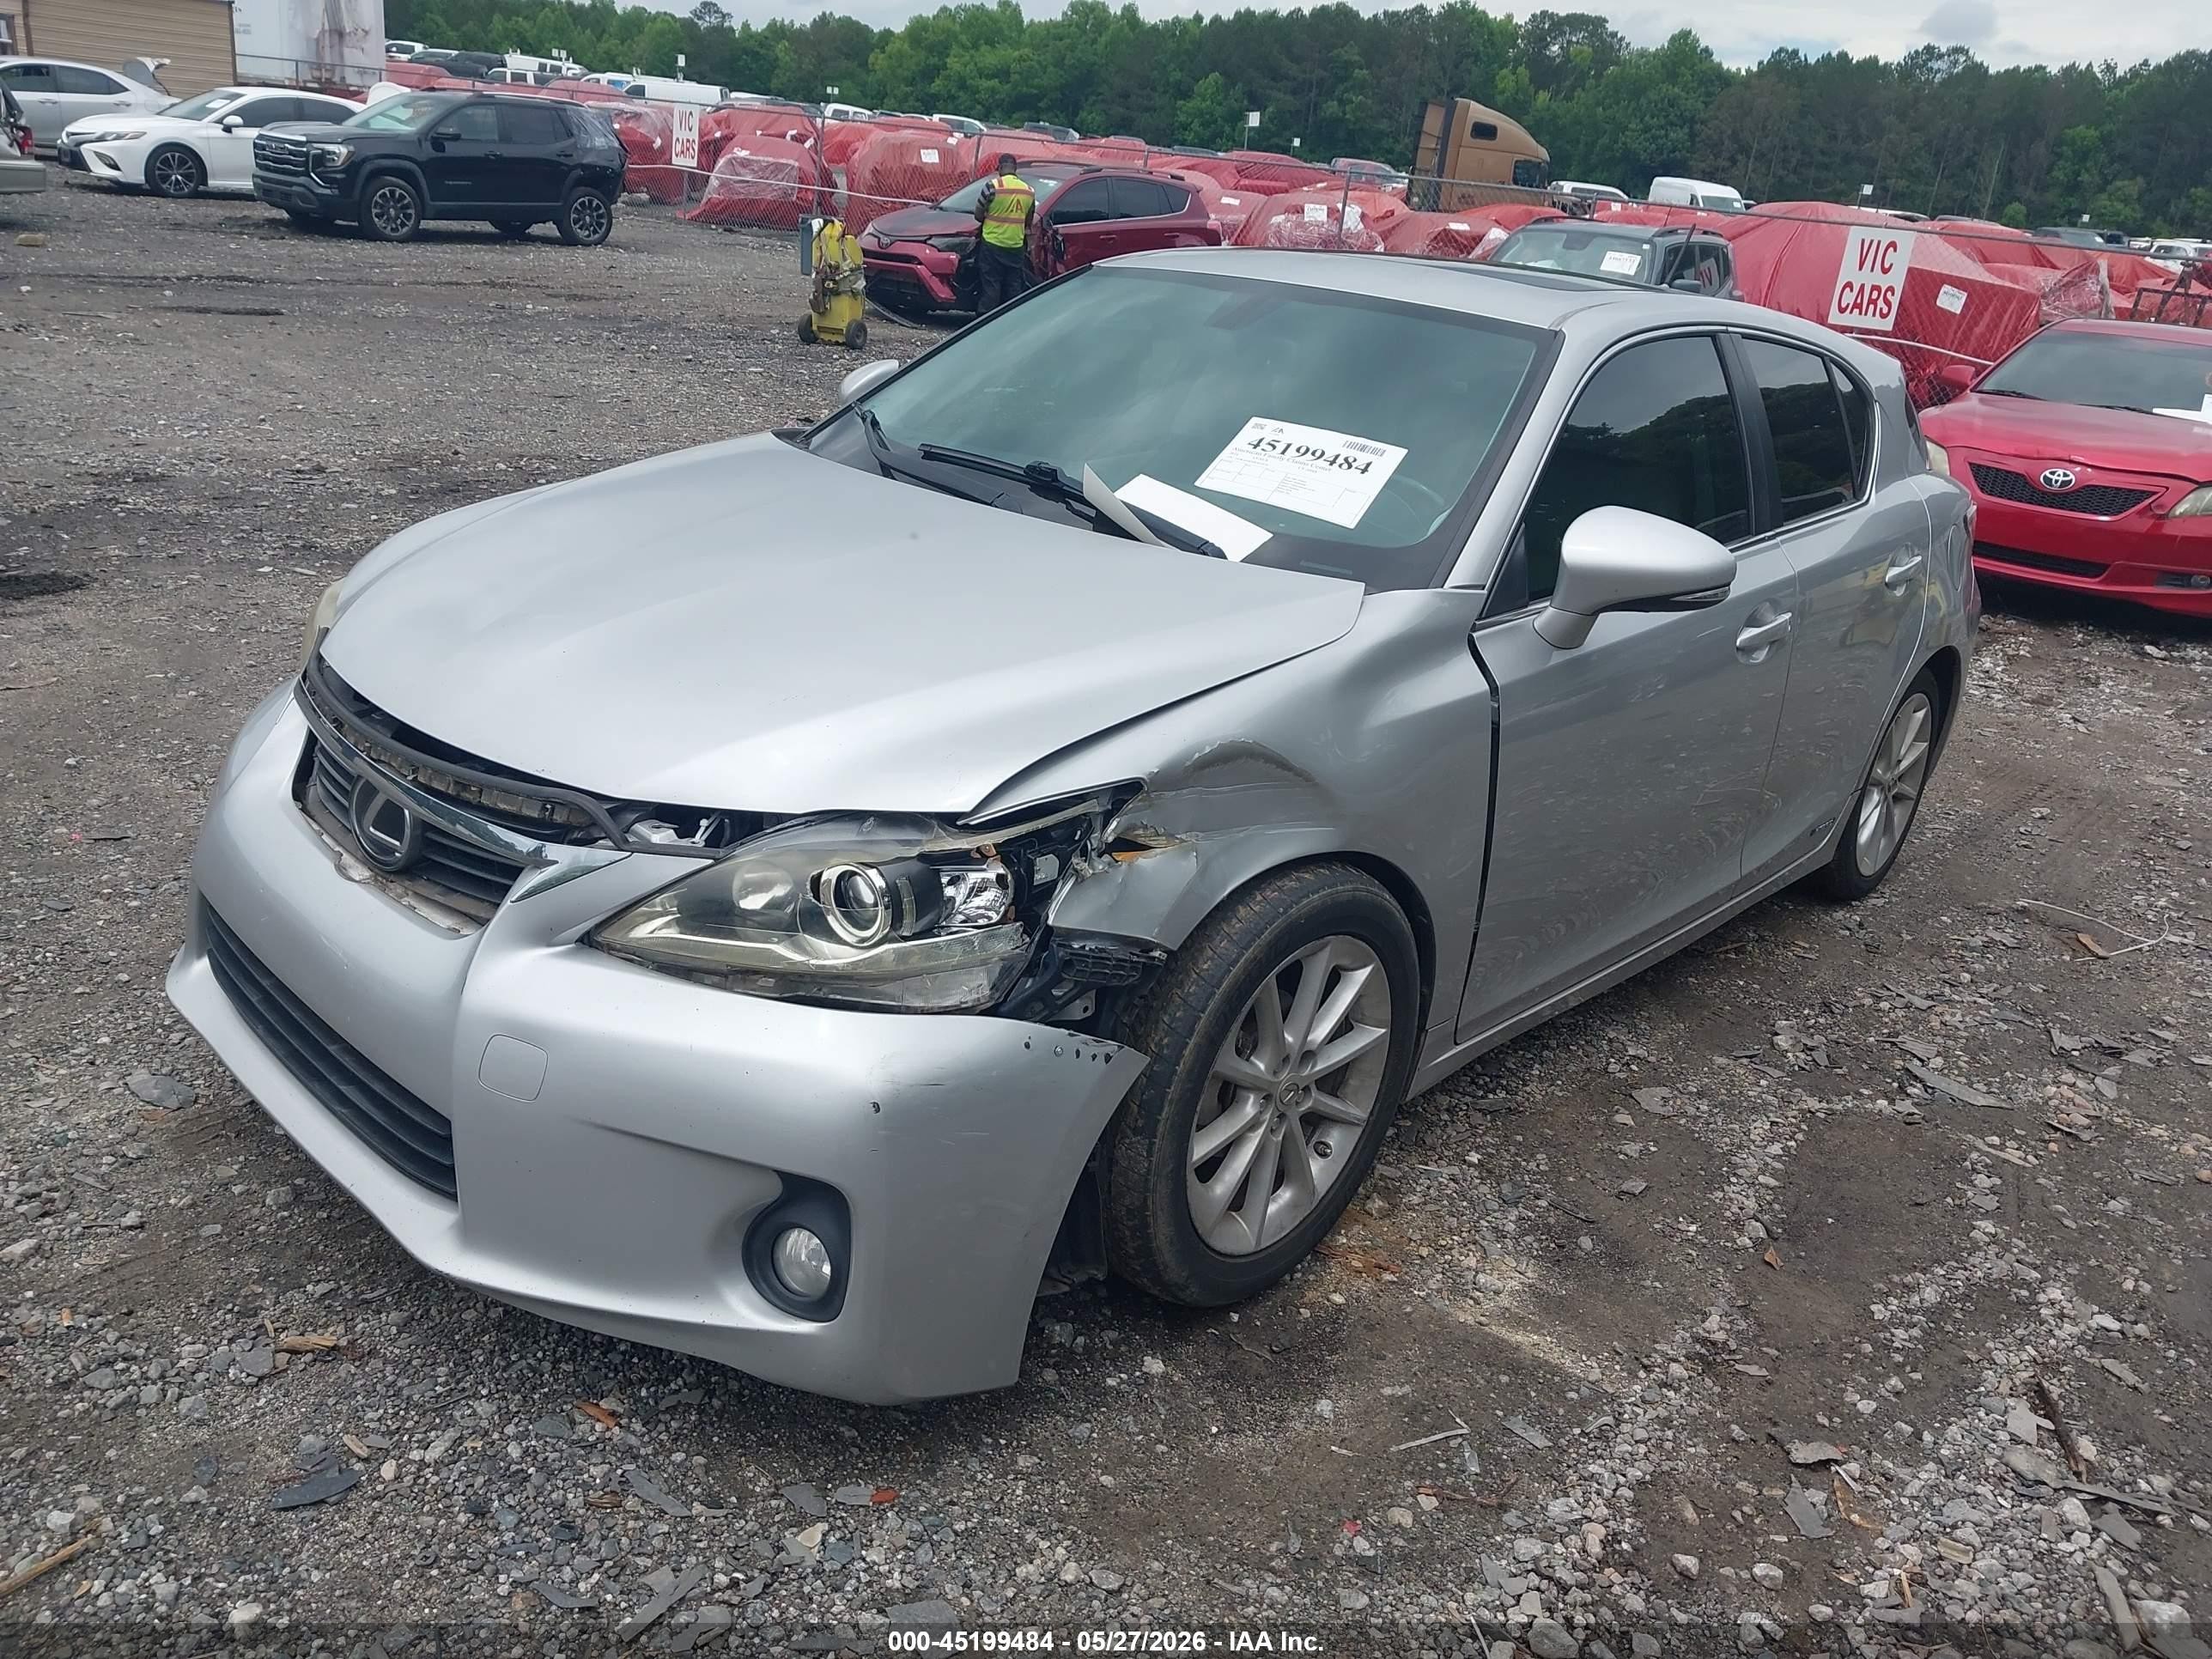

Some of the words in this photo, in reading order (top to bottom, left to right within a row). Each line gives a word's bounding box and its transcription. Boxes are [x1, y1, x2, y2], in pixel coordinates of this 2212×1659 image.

[678, 109, 694, 132] VIC
[674, 137, 696, 161] CARS
[1857, 237, 1899, 276] VIC
[1837, 280, 1896, 319] CARS
[1248, 436, 1373, 474] 45199484
